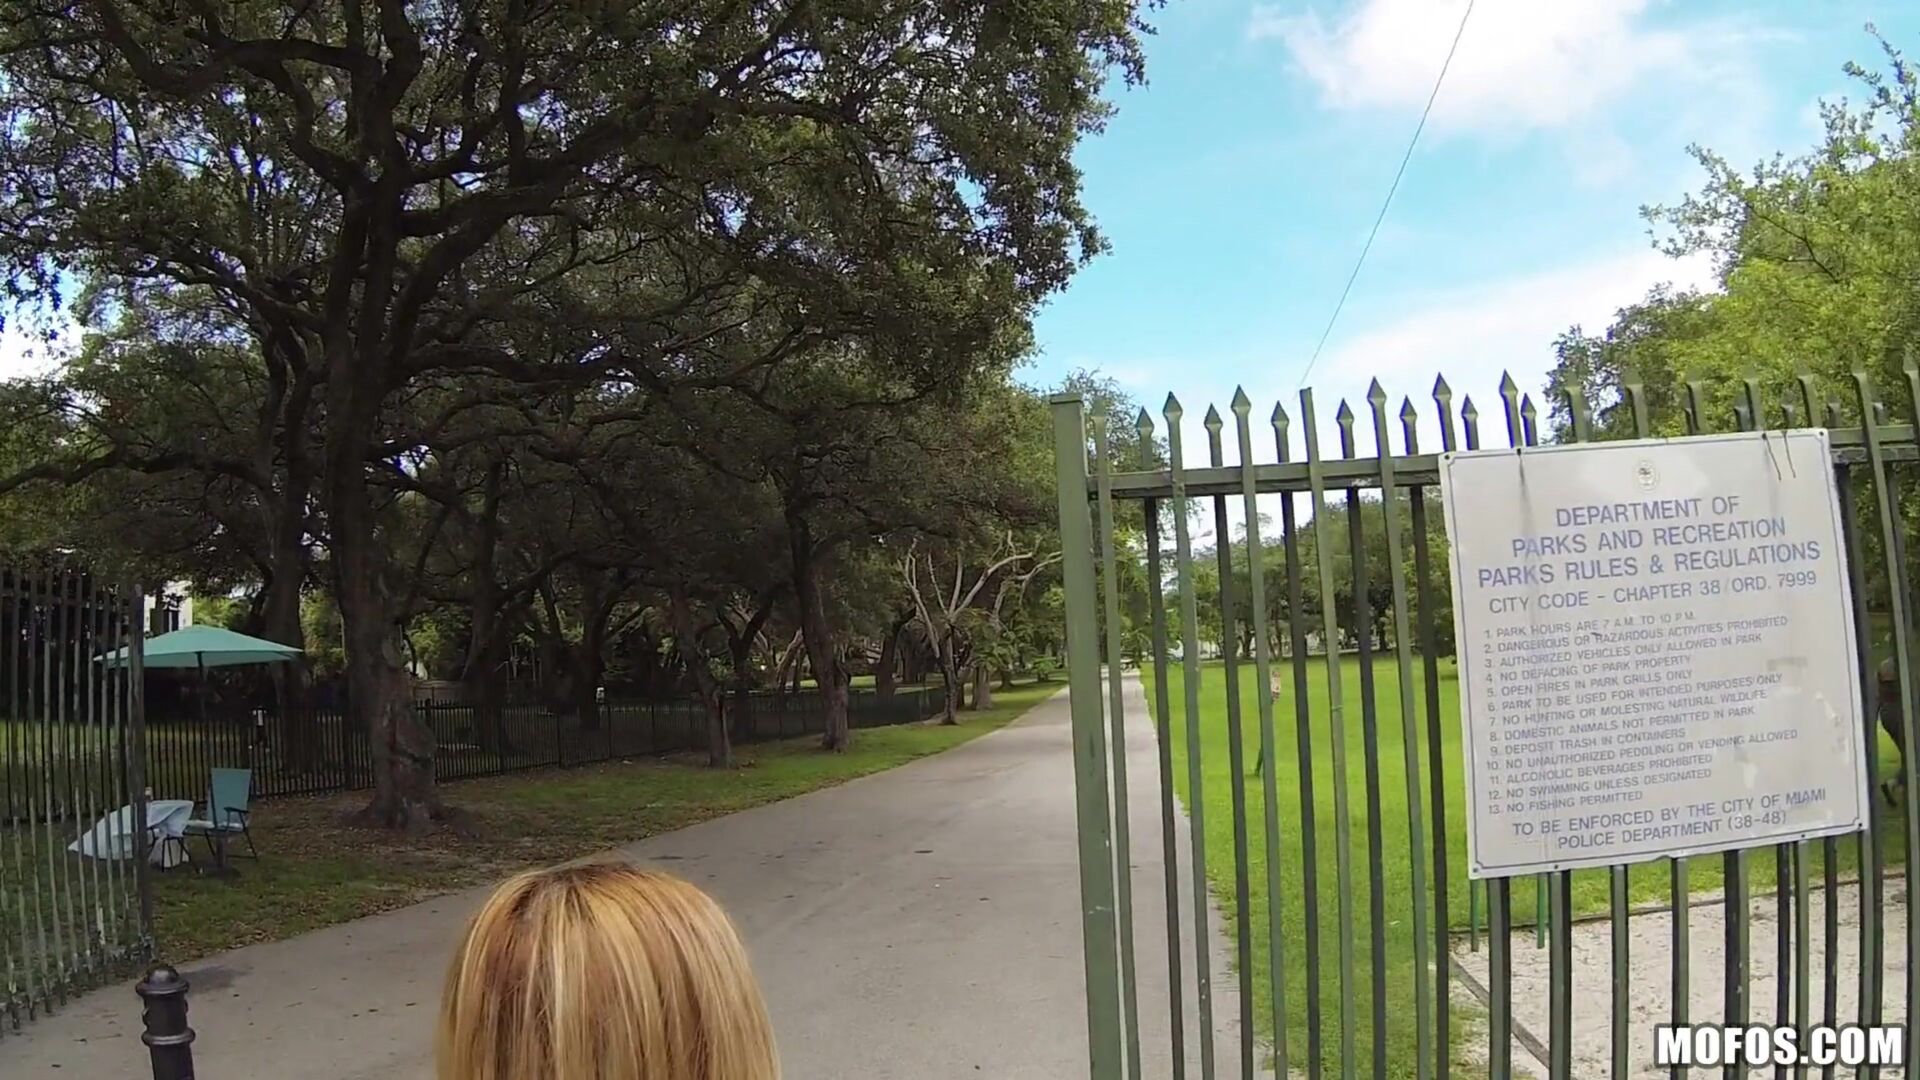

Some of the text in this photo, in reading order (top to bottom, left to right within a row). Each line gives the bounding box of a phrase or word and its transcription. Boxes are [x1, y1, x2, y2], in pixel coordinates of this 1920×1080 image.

[1557, 496, 1740, 527] DEPARTMENT OF
[1512, 517, 1785, 558] PARKS AND RECREATION
[1478, 541, 1821, 588] PARKS RULES & REGULATIONS
[1489, 597, 1529, 614] CITY
[1538, 594, 1589, 610] CODE
[1613, 582, 1692, 604] CHAPTER
[1700, 580, 1720, 596] 38
[1732, 575, 1771, 592] ORD.
[1778, 571, 1817, 588] 7999
[1496, 626, 1526, 637] PARK
[1531, 622, 1571, 635] HOURS
[1577, 619, 1598, 631] ARE
[1603, 619, 1610, 628] 7
[1641, 615, 1655, 625] TO
[1660, 613, 1671, 623] 10
[1498, 637, 1569, 652] DANGEROUS
[1574, 635, 1590, 646] OR
[1595, 629, 1663, 643] HAZARDOUS
[1668, 622, 1723, 637] ACTIVITIES
[1727, 615, 1788, 630] PROHIBITED
[1500, 651, 1571, 667] AUTHORIZED
[1577, 646, 1630, 659] VEHICLES
[1635, 643, 1662, 654] ONLY
[1667, 638, 1716, 651] ALLOWED
[1721, 636, 1731, 645] IN
[1735, 634, 1762, 644] PARK
[1500, 671, 1517, 681] NO
[1522, 665, 1578, 679] DEFACING
[1583, 663, 1598, 674] OF
[1602, 661, 1630, 672] PARK
[1635, 655, 1691, 669] PROPERTY
[1501, 685, 1532, 696] OPEN
[1537, 681, 1569, 692] FIRES
[1575, 679, 1585, 689] IN
[1590, 676, 1618, 687] PARK
[1623, 672, 1661, 684] GRILLS
[1666, 670, 1692, 681] ONLY
[1502, 699, 1531, 710] PARK
[1536, 697, 1552, 707] TO
[1557, 695, 1571, 705] BE
[1577, 692, 1607, 704] USED
[1612, 689, 1634, 700] FOR
[1639, 683, 1692, 697] INTENDED
[1696, 677, 1753, 691] PURPOSES
[1757, 673, 1782, 685] ONLY
[1503, 715, 1520, 725] NO
[1525, 710, 1575, 723] HUNTING
[1580, 708, 1596, 717] OR
[1601, 701, 1665, 716] MOLESTING
[1669, 697, 1716, 709] NATURAL
[1720, 689, 1767, 703] WILDLIFE
[1504, 726, 1563, 740] DOMESTIC
[1569, 720, 1618, 734] ANIMALS
[1623, 718, 1645, 728] NOT
[1649, 711, 1709, 726] PERMITTED
[1714, 709, 1724, 718] IN
[1728, 706, 1756, 716] PARK
[1505, 741, 1555, 755] DEPOSIT
[1560, 738, 1596, 750] TRASH
[1602, 736, 1612, 745] IN
[1617, 728, 1686, 743] CONTAINERS
[1506, 759, 1522, 769] NO
[1528, 750, 1615, 767] UNAUTHORIZED
[1620, 743, 1674, 758] PEDDLING
[1678, 741, 1693, 752] OR
[1698, 736, 1745, 749] VENDING
[1749, 729, 1798, 743] ALLOWED
[1506, 769, 1573, 783] ALCOHOLIC
[1578, 761, 1644, 776] BEVERAGES
[1649, 755, 1712, 769] PROHIBITED
[1506, 788, 1523, 798] NO
[1529, 782, 1589, 797] SWIMMING
[1594, 777, 1639, 790] UNLESS
[1644, 769, 1711, 784] DESIGNATED
[1507, 802, 1524, 812] NO
[1529, 798, 1575, 811] FISHING
[1580, 791, 1643, 805] PERMITTED
[1512, 788, 1826, 835] TO BE ENFORCED BY THE CITY OF MIAMI
[1558, 810, 1786, 849] POLICE DEPARTMENT (38-48)
